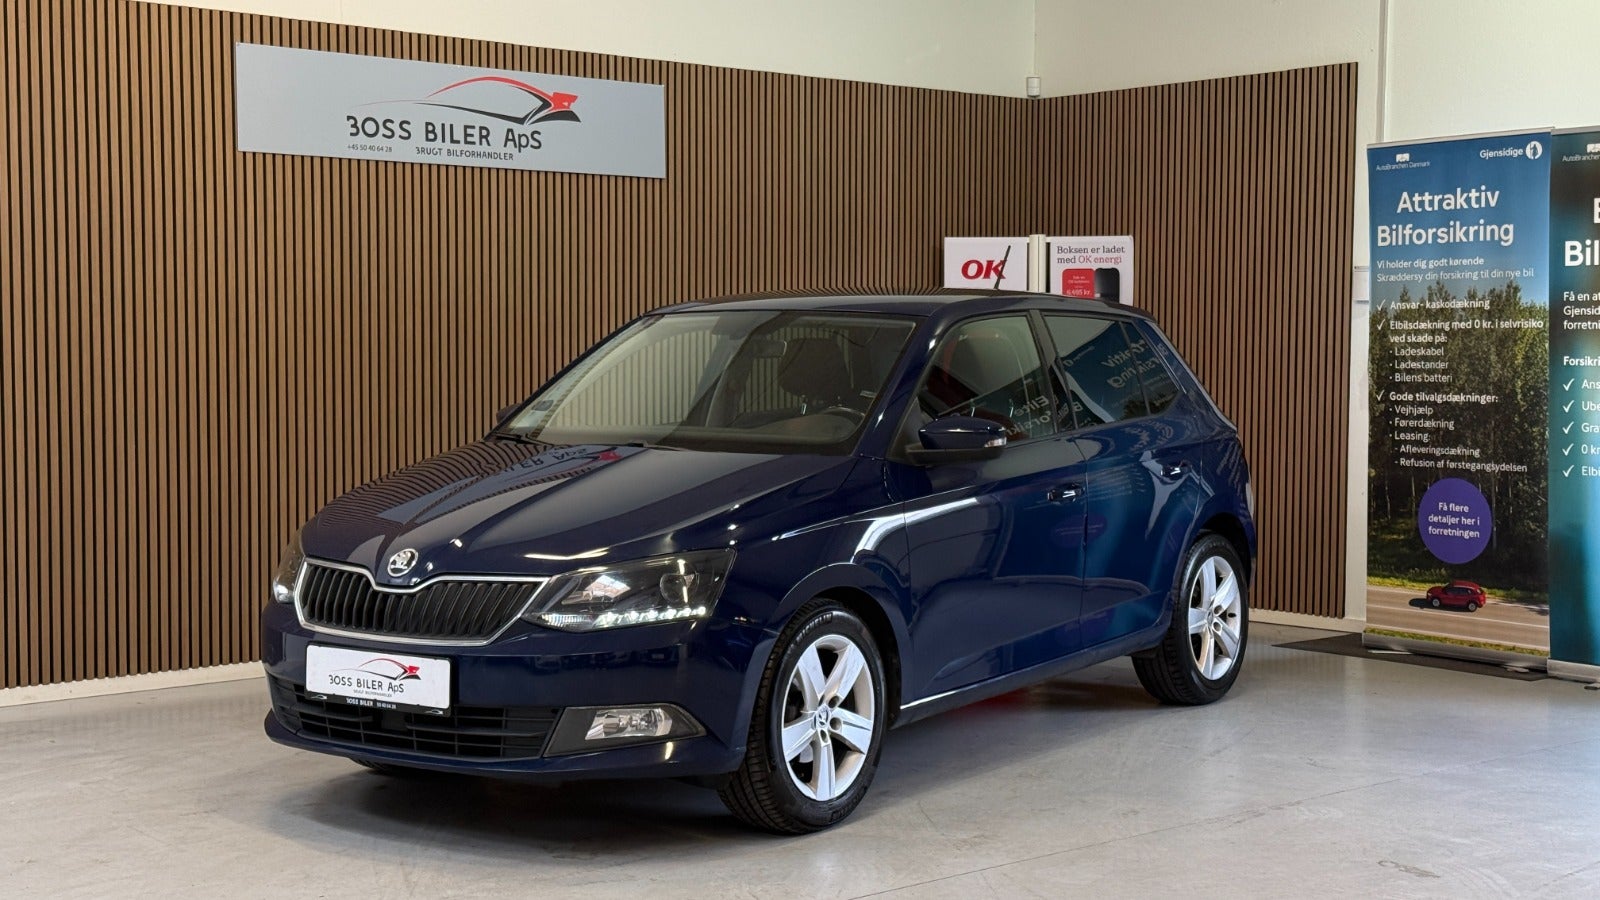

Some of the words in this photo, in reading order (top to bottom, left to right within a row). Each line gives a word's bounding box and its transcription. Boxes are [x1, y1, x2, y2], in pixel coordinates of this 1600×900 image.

[425, 122, 491, 146] BILER
[504, 128, 542, 153] ApS
[447, 149, 513, 160] BILFORHANDLER
[1480, 147, 1523, 160] Gjensidige
[1397, 185, 1500, 213] Attraktiv
[1378, 219, 1514, 246] Bilforsikring
[1057, 246, 1088, 254] Boksen
[1102, 245, 1125, 253] ladet
[1057, 256, 1076, 264] med
[1078, 256, 1091, 264] OK
[1094, 256, 1122, 265] energi
[1377, 261, 1385, 269] Vi
[1386, 260, 1412, 268] holder
[1414, 259, 1426, 270] dig
[1429, 258, 1448, 269] godt
[1450, 256, 1484, 266] kørende
[961, 260, 1007, 280] OK
[1376, 273, 1423, 283] Skræddersy
[1425, 272, 1438, 280] din
[1440, 270, 1478, 281] forsikring
[1480, 270, 1489, 279] til
[1491, 270, 1503, 278] din
[1506, 270, 1520, 280] nye
[1523, 268, 1534, 277] bil
[1564, 291, 1575, 301] Få
[1426, 300, 1490, 310] kaskodækning
[1390, 320, 1450, 331] Elbilsdækning
[1452, 320, 1472, 329] med
[1474, 320, 1480, 329] 0
[1482, 320, 1494, 329] kr.
[1500, 319, 1544, 329] selvrisiko
[1390, 335, 1405, 343] ved
[1407, 334, 1432, 343] skade
[1434, 334, 1447, 345] på:
[1395, 347, 1444, 356] Ladeskabel
[1395, 360, 1449, 369] Ladestander
[1395, 373, 1422, 382] Bilens
[1424, 373, 1452, 382] batteri
[1390, 392, 1413, 401] Gode
[1416, 392, 1498, 404] tilvalgsdækninger:
[1394, 405, 1433, 415] Vejhjælp
[1394, 418, 1454, 430] Førerdækning
[1394, 431, 1430, 442] Leasing:
[1400, 445, 1480, 457] Afleveringsdækning
[1400, 458, 1435, 468] Refusion
[1436, 459, 1444, 468] af
[1446, 459, 1527, 473] førstegangsydelsen
[1438, 502, 1448, 511] Få
[1450, 503, 1469, 512] flere
[1428, 514, 1459, 526] detaljer
[1461, 516, 1475, 525] her
[1428, 526, 1480, 539] forretningen
[356, 678, 383, 691] BILER
[388, 682, 404, 694] ApS
